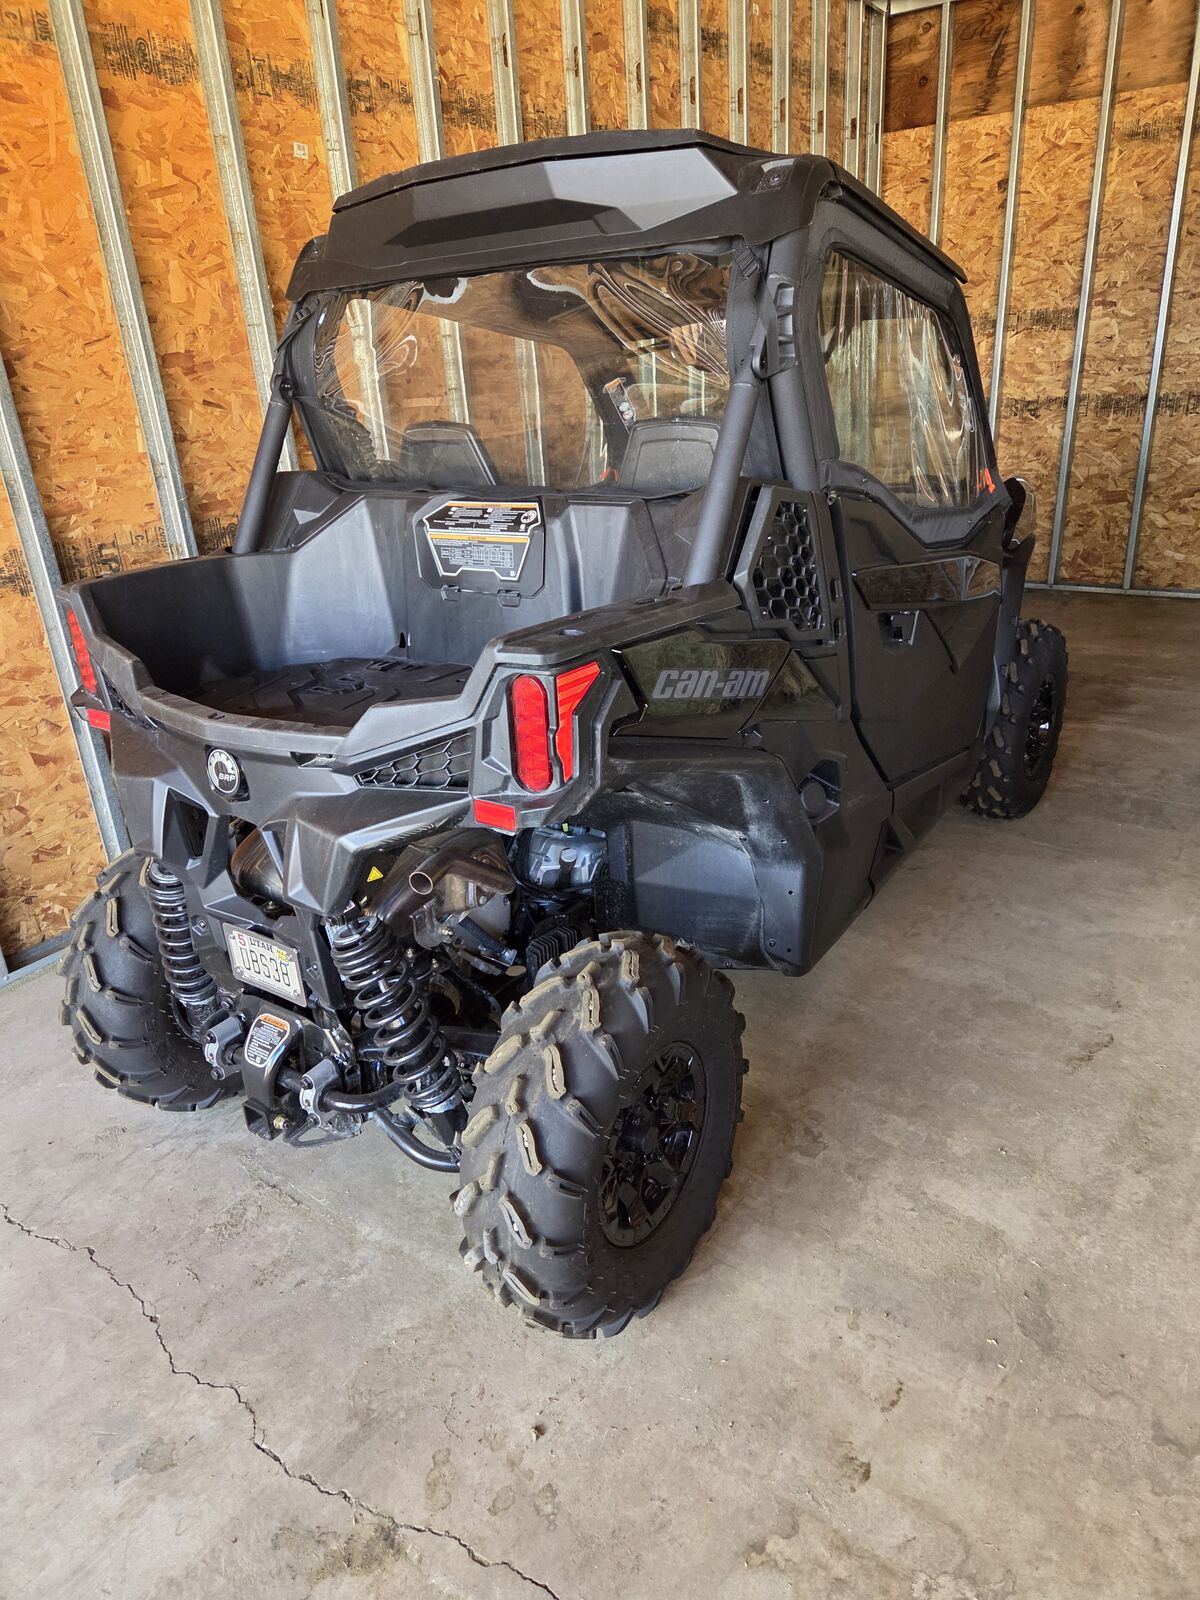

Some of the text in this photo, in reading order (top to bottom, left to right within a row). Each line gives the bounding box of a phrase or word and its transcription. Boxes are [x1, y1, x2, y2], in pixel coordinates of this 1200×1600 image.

[219, 772, 236, 782] BRP
[237, 932, 274, 953] 5 UTAH
